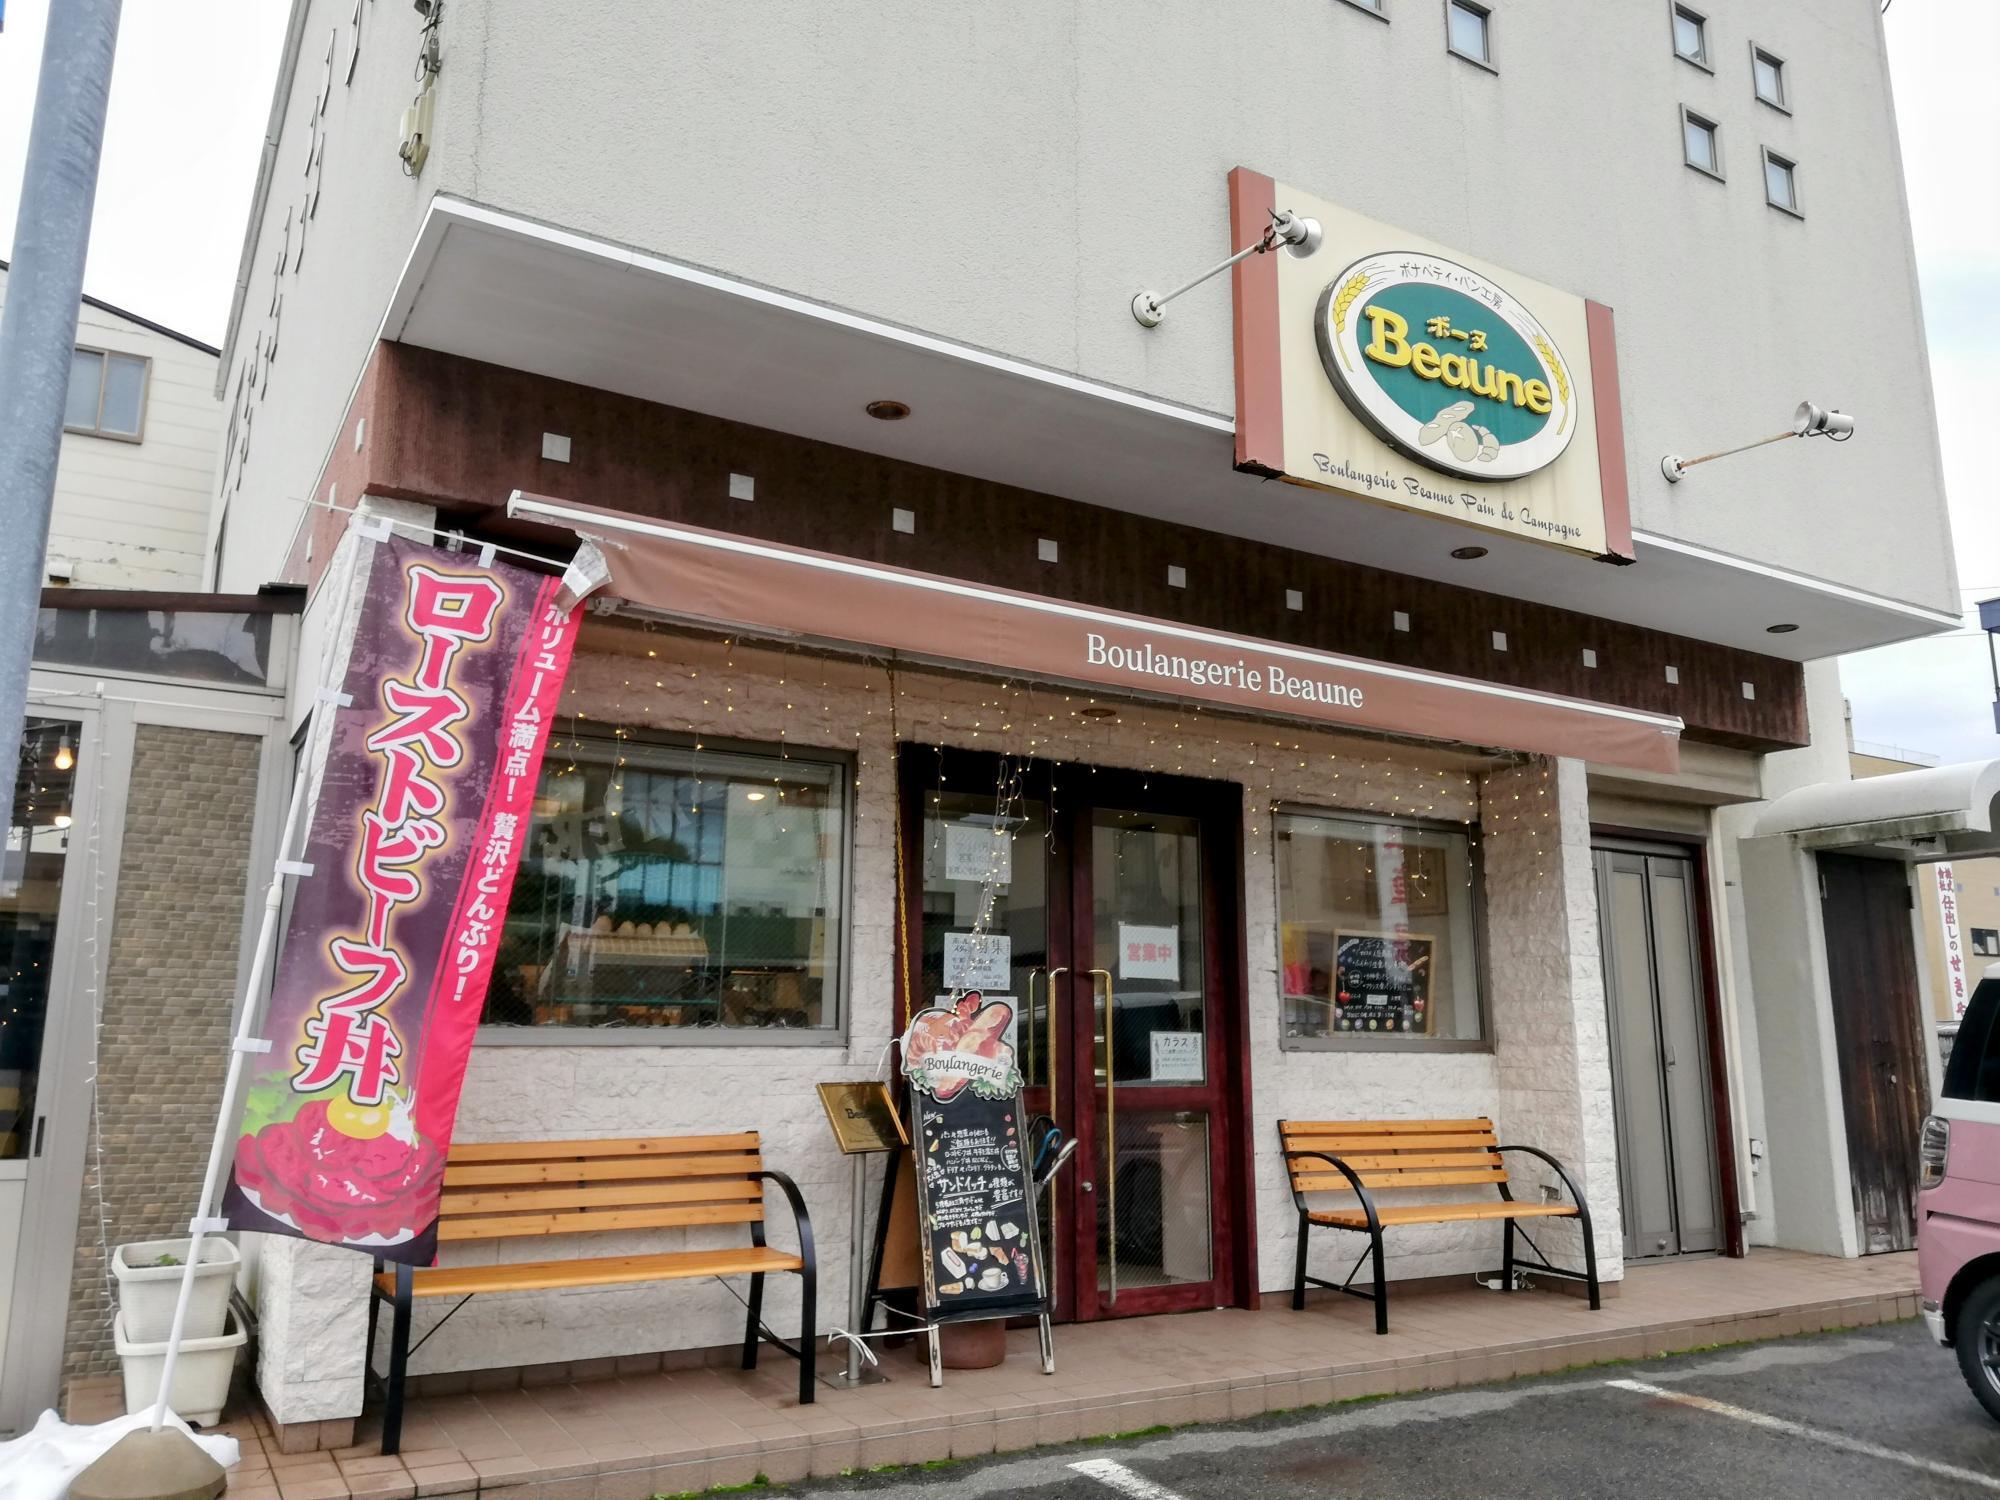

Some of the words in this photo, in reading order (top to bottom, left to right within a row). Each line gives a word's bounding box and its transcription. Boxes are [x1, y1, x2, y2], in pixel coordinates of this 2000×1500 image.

[1365, 305, 1553, 414] Beaune
[1312, 452, 1398, 491] Boulangerie
[1403, 476, 1455, 506] Beaune
[1460, 492, 1496, 518] Pain
[1501, 501, 1516, 521] de
[1519, 507, 1582, 540] Campagne
[1087, 633, 1262, 693] Boulangerie
[1267, 666, 1364, 709] Beaune
[291, 564, 505, 1106] ローストビーフ丼
[1126, 942, 1172, 963] 営業中
[924, 1055, 1003, 1081] Boulangerie
